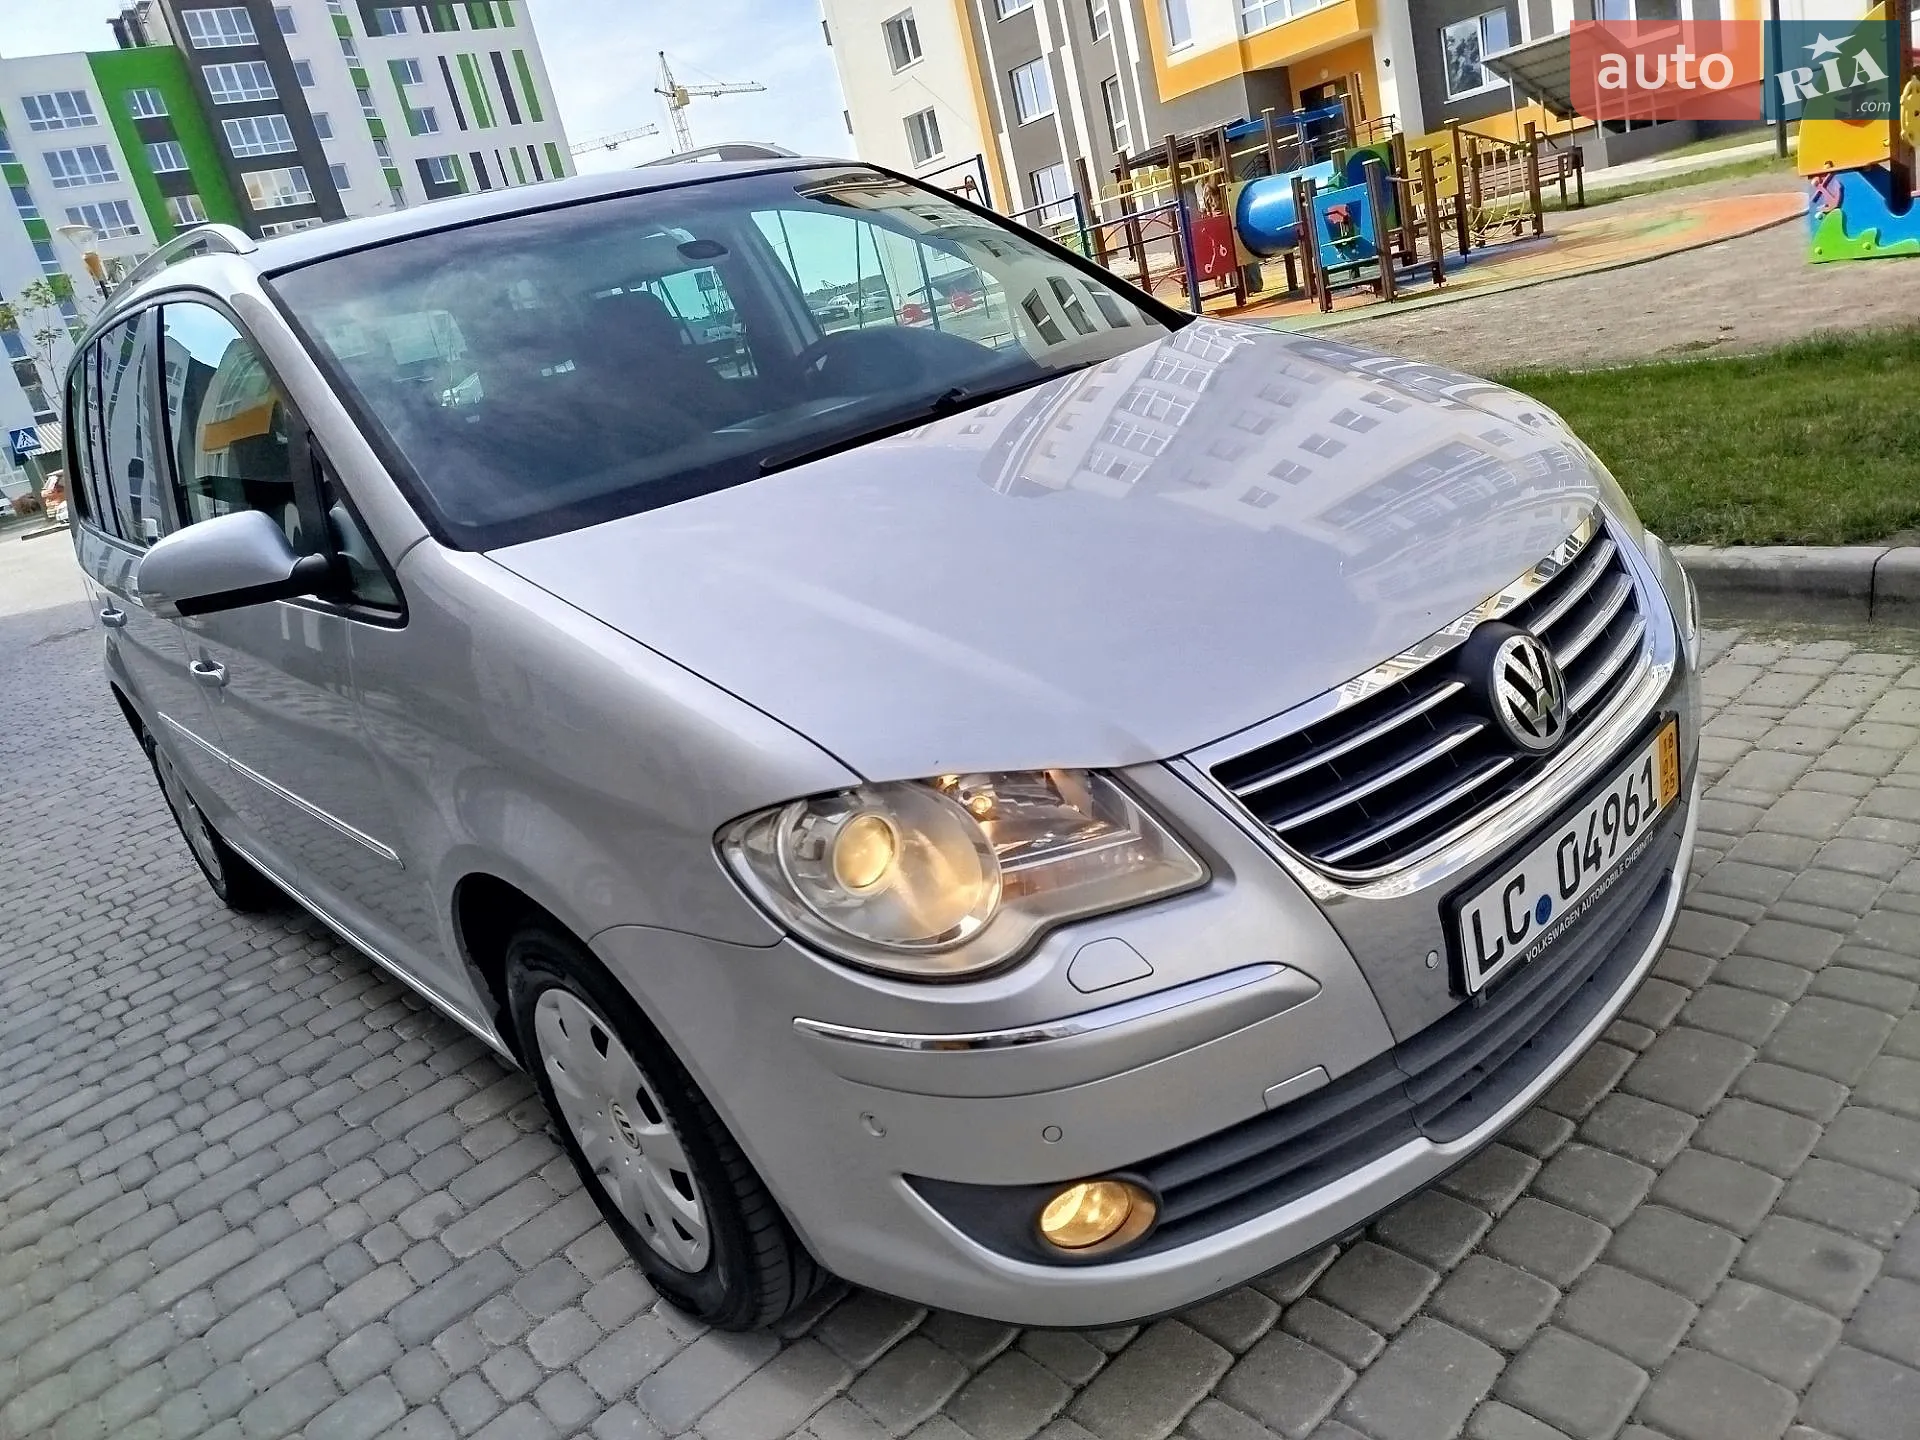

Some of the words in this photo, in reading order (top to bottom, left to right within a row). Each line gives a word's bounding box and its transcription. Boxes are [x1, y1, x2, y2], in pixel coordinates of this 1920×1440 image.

[1472, 873, 1531, 976] LC
[1556, 755, 1659, 901] 04961
[1525, 909, 1581, 963] VOLKSWAGEN
[1581, 862, 1625, 914] AUTOMOBILE
